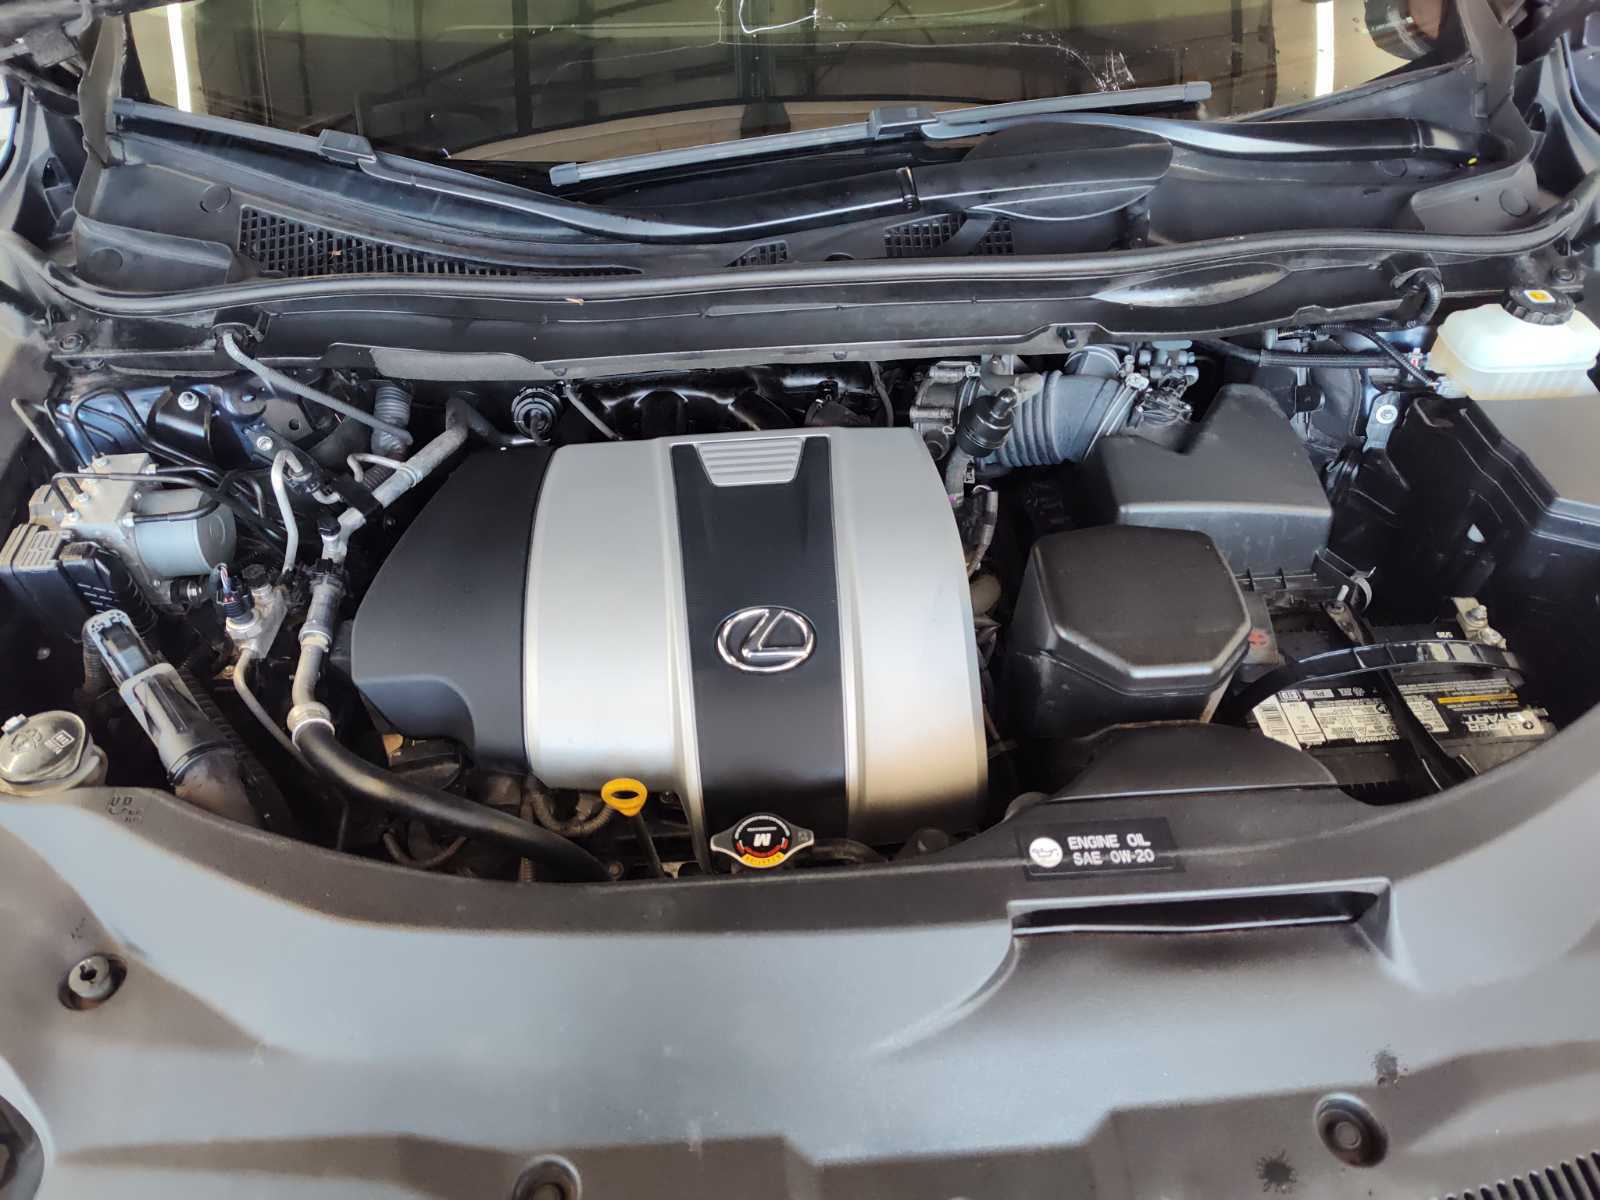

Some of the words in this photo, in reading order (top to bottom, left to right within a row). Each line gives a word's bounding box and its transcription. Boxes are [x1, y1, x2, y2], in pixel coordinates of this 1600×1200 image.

[1067, 834, 1120, 850] ENGINE
[1126, 832, 1152, 848] OIL
[1072, 850, 1103, 866] SAE
[1109, 848, 1155, 864] 0W-20
